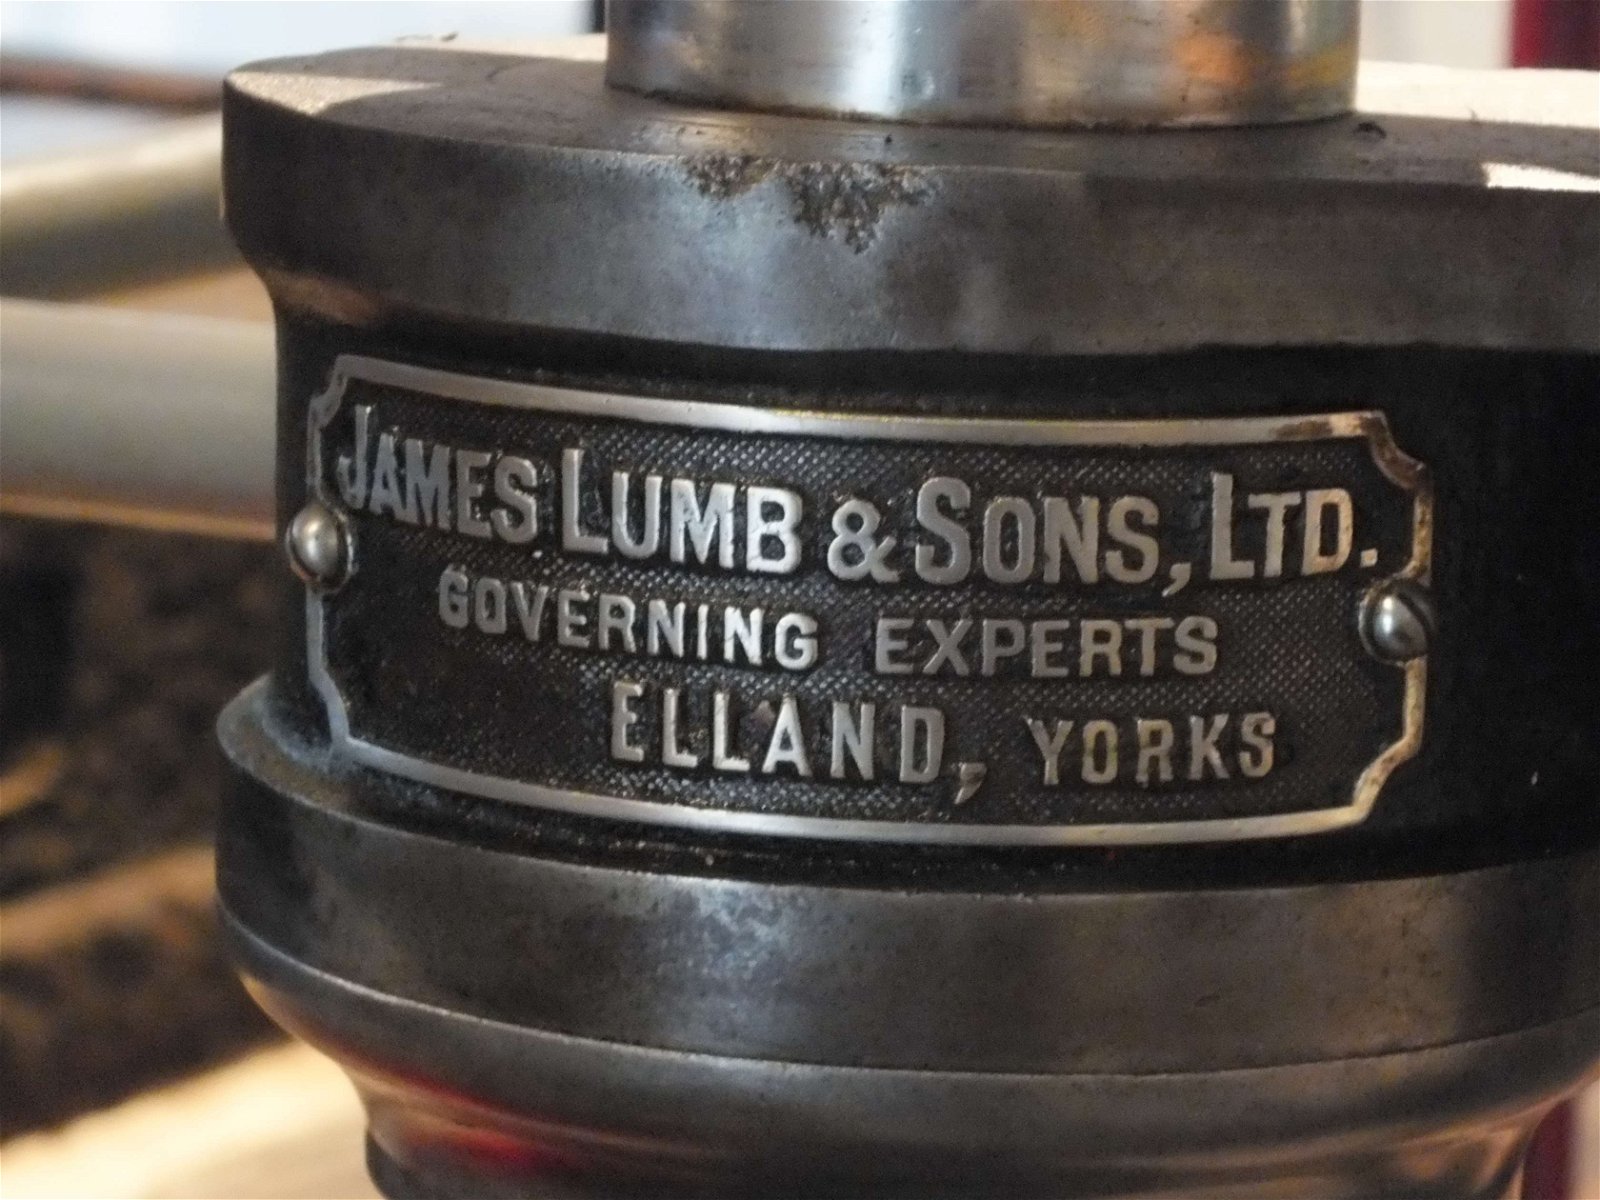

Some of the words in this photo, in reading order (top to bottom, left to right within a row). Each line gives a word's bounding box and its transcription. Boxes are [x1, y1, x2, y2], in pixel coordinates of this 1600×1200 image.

[338, 404, 538, 544] JAMES
[563, 448, 799, 573] LUMB
[826, 499, 898, 583] &
[915, 476, 1192, 597] SONS,
[1211, 473, 1378, 579] LTD.
[439, 569, 819, 670] GOVERNING
[877, 617, 1219, 677] EXPERTS
[612, 683, 983, 804] ELLAND,
[1027, 712, 1276, 785] YORKS
